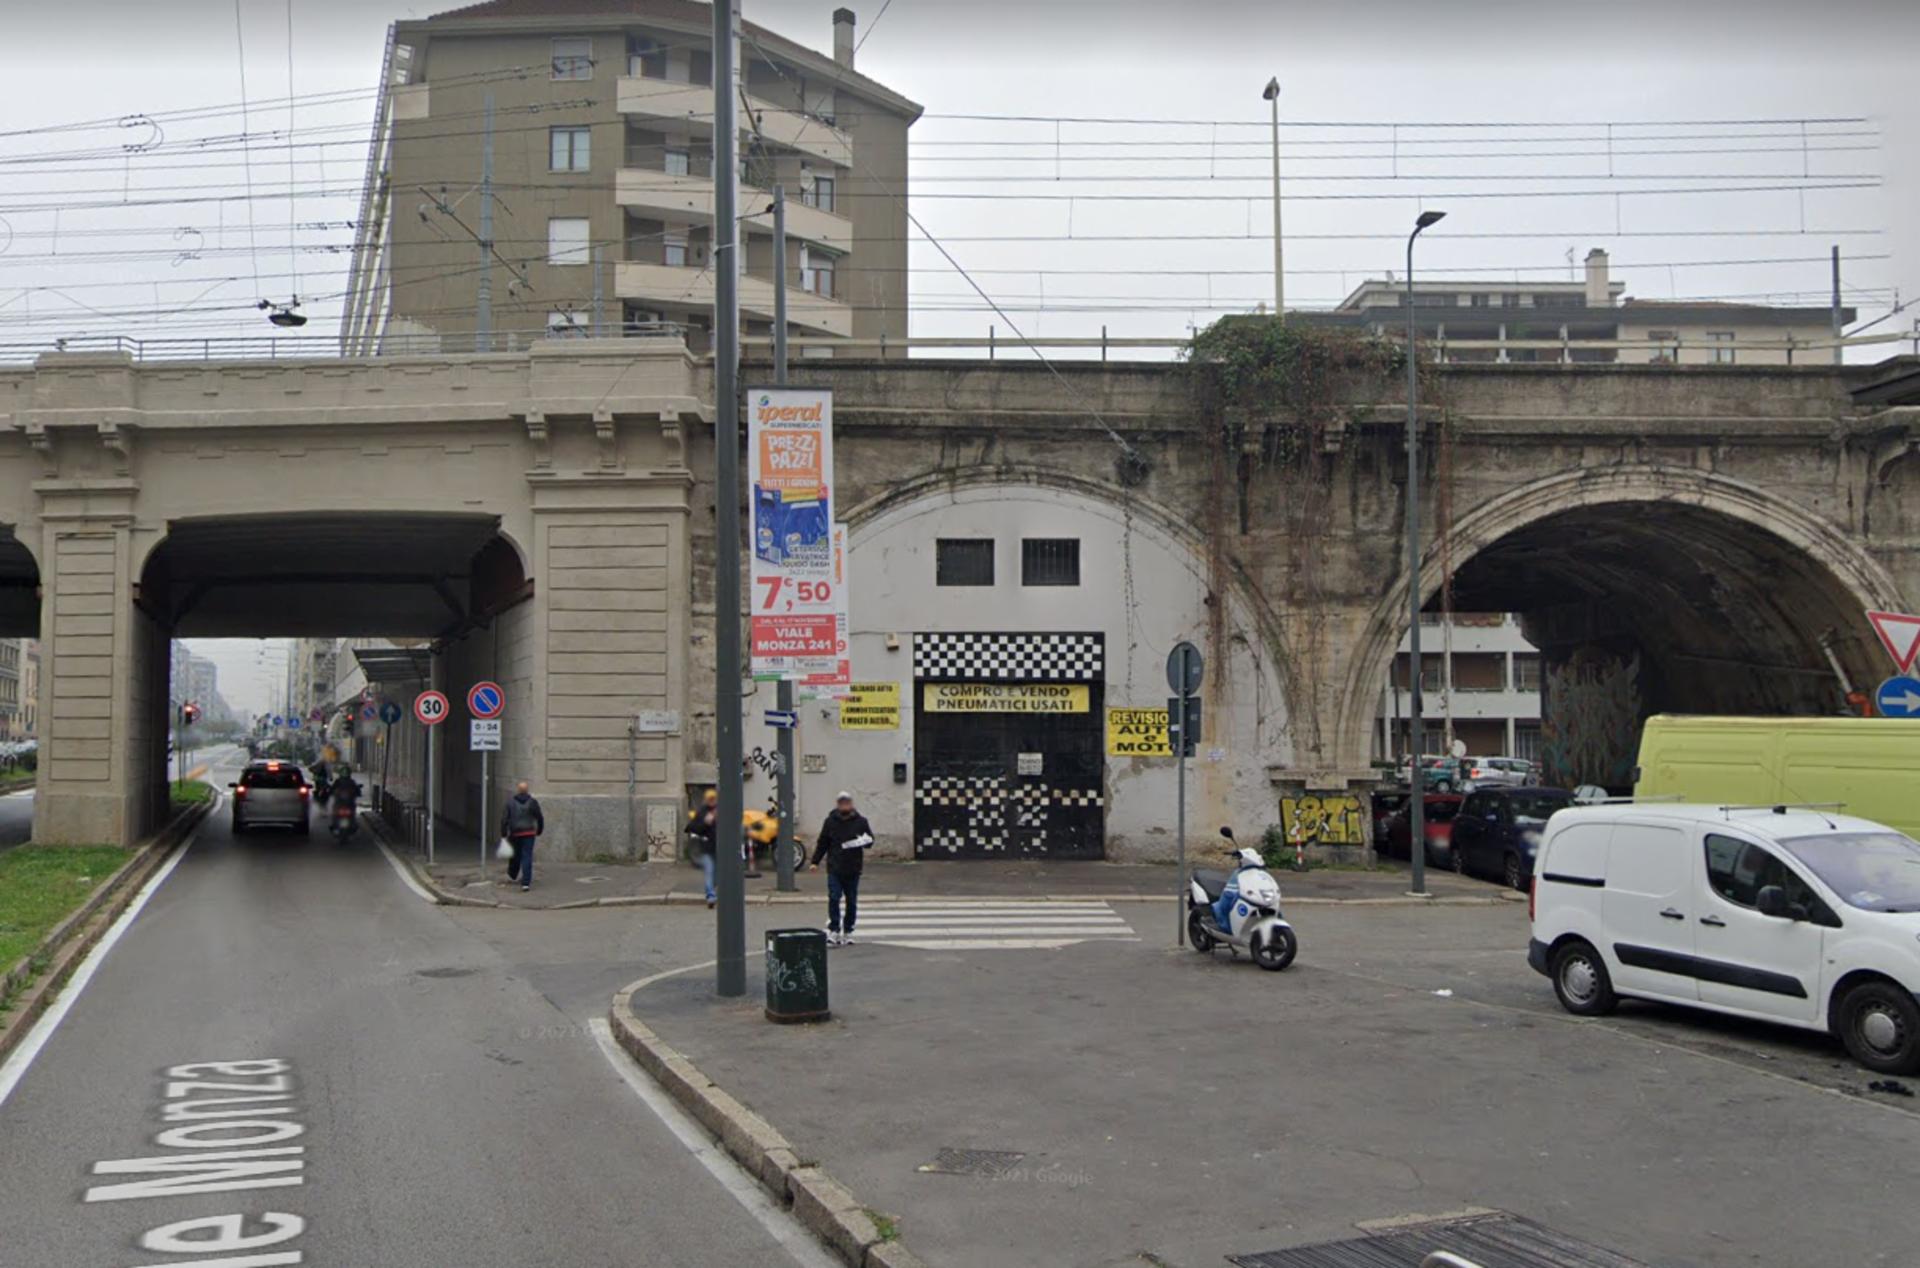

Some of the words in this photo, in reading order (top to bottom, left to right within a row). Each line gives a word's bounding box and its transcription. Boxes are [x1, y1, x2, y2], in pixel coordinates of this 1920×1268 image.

[767, 434, 816, 452] PREZZI
[769, 450, 814, 469] PAZZI
[775, 628, 813, 638] VIALE
[757, 640, 805, 651] MONZA
[808, 640, 832, 650] 241
[940, 686, 1003, 697] COMPRO
[1008, 687, 1015, 697] E
[1021, 687, 1071, 697] VENDO
[422, 699, 442, 715] 30
[937, 698, 1027, 710] PNEUMATICI
[1031, 699, 1074, 711] USATI
[487, 723, 498, 731] 24
[1118, 725, 1168, 735] AUT
[1143, 734, 1157, 742] e
[85, 1058, 305, 1202] Monza
